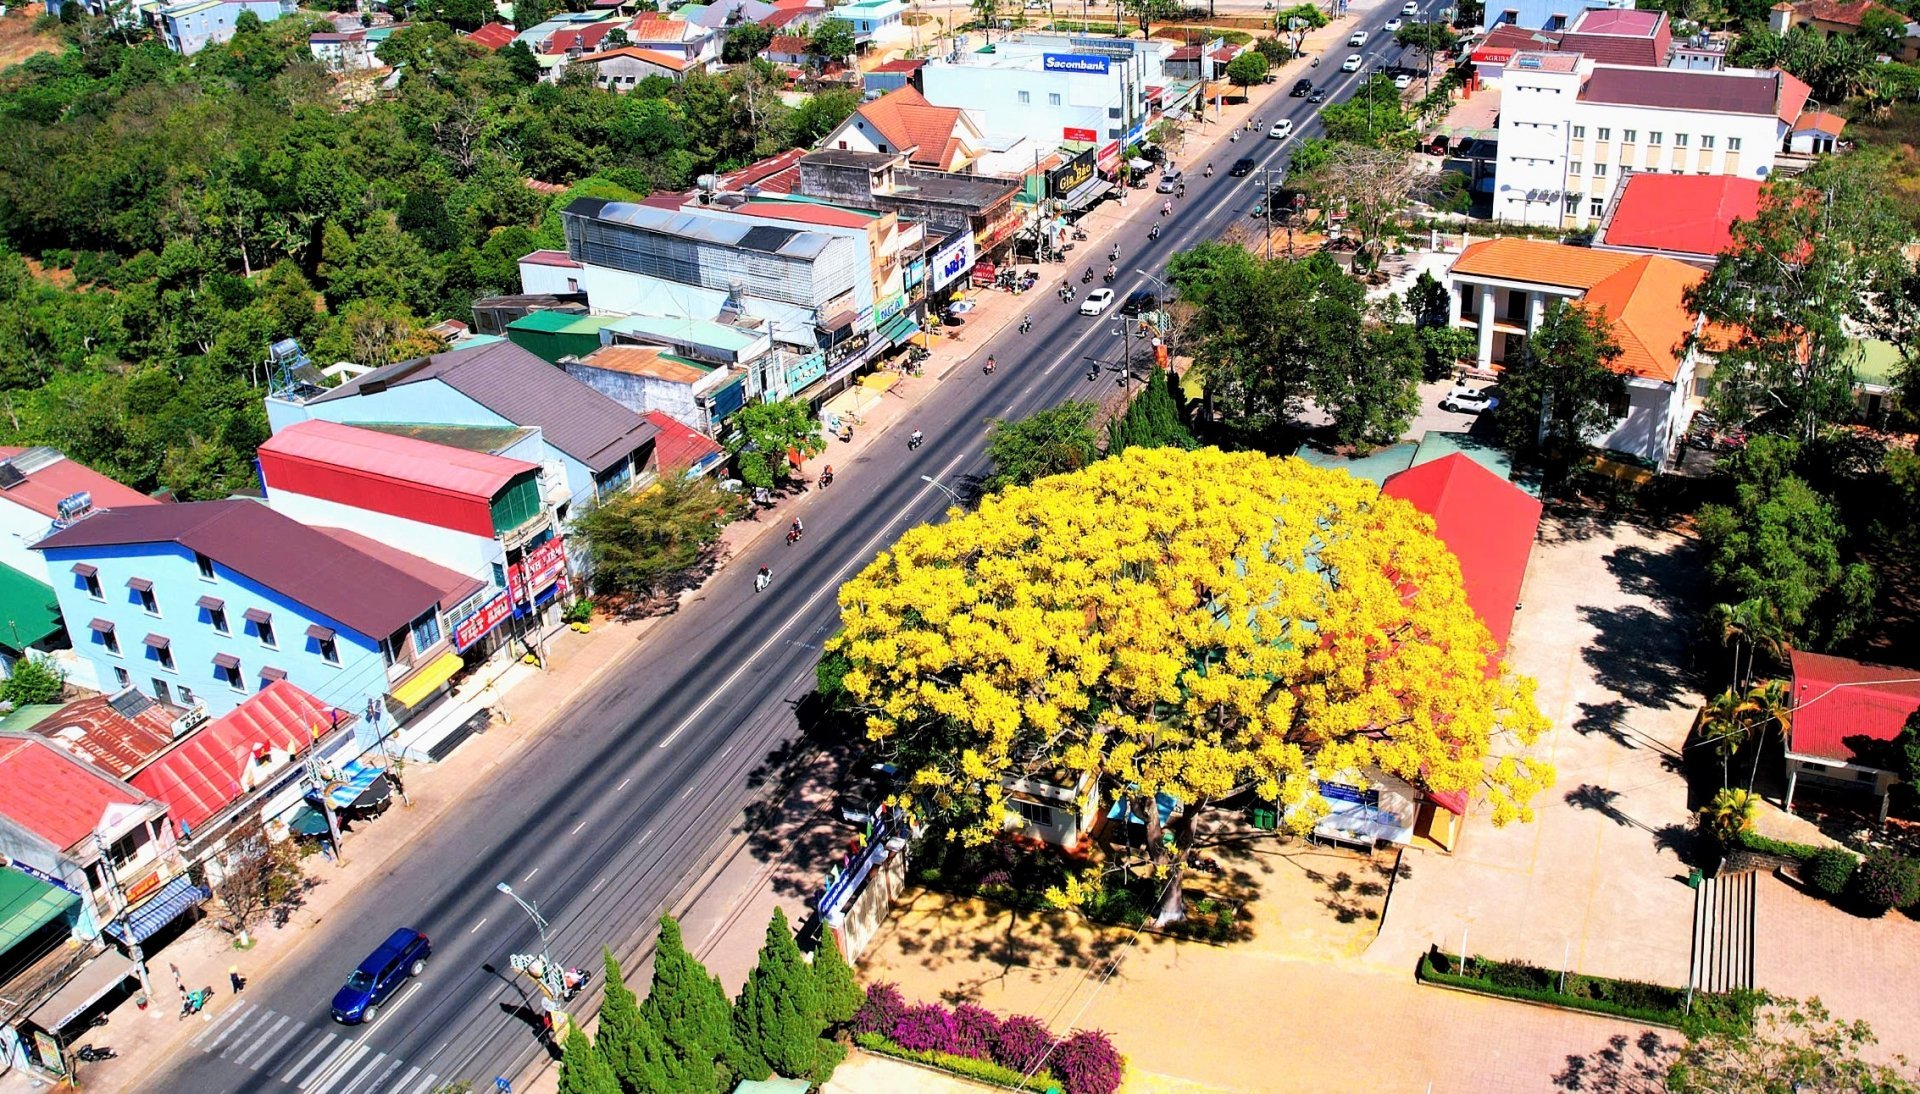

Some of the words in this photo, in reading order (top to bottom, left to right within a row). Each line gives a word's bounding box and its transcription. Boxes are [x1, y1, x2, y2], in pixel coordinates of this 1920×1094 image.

[1046, 56, 1105, 71] Sacombank
[1060, 176, 1074, 190] Gia
[880, 300, 901, 320] NGA
[185, 712, 202, 728] 629
